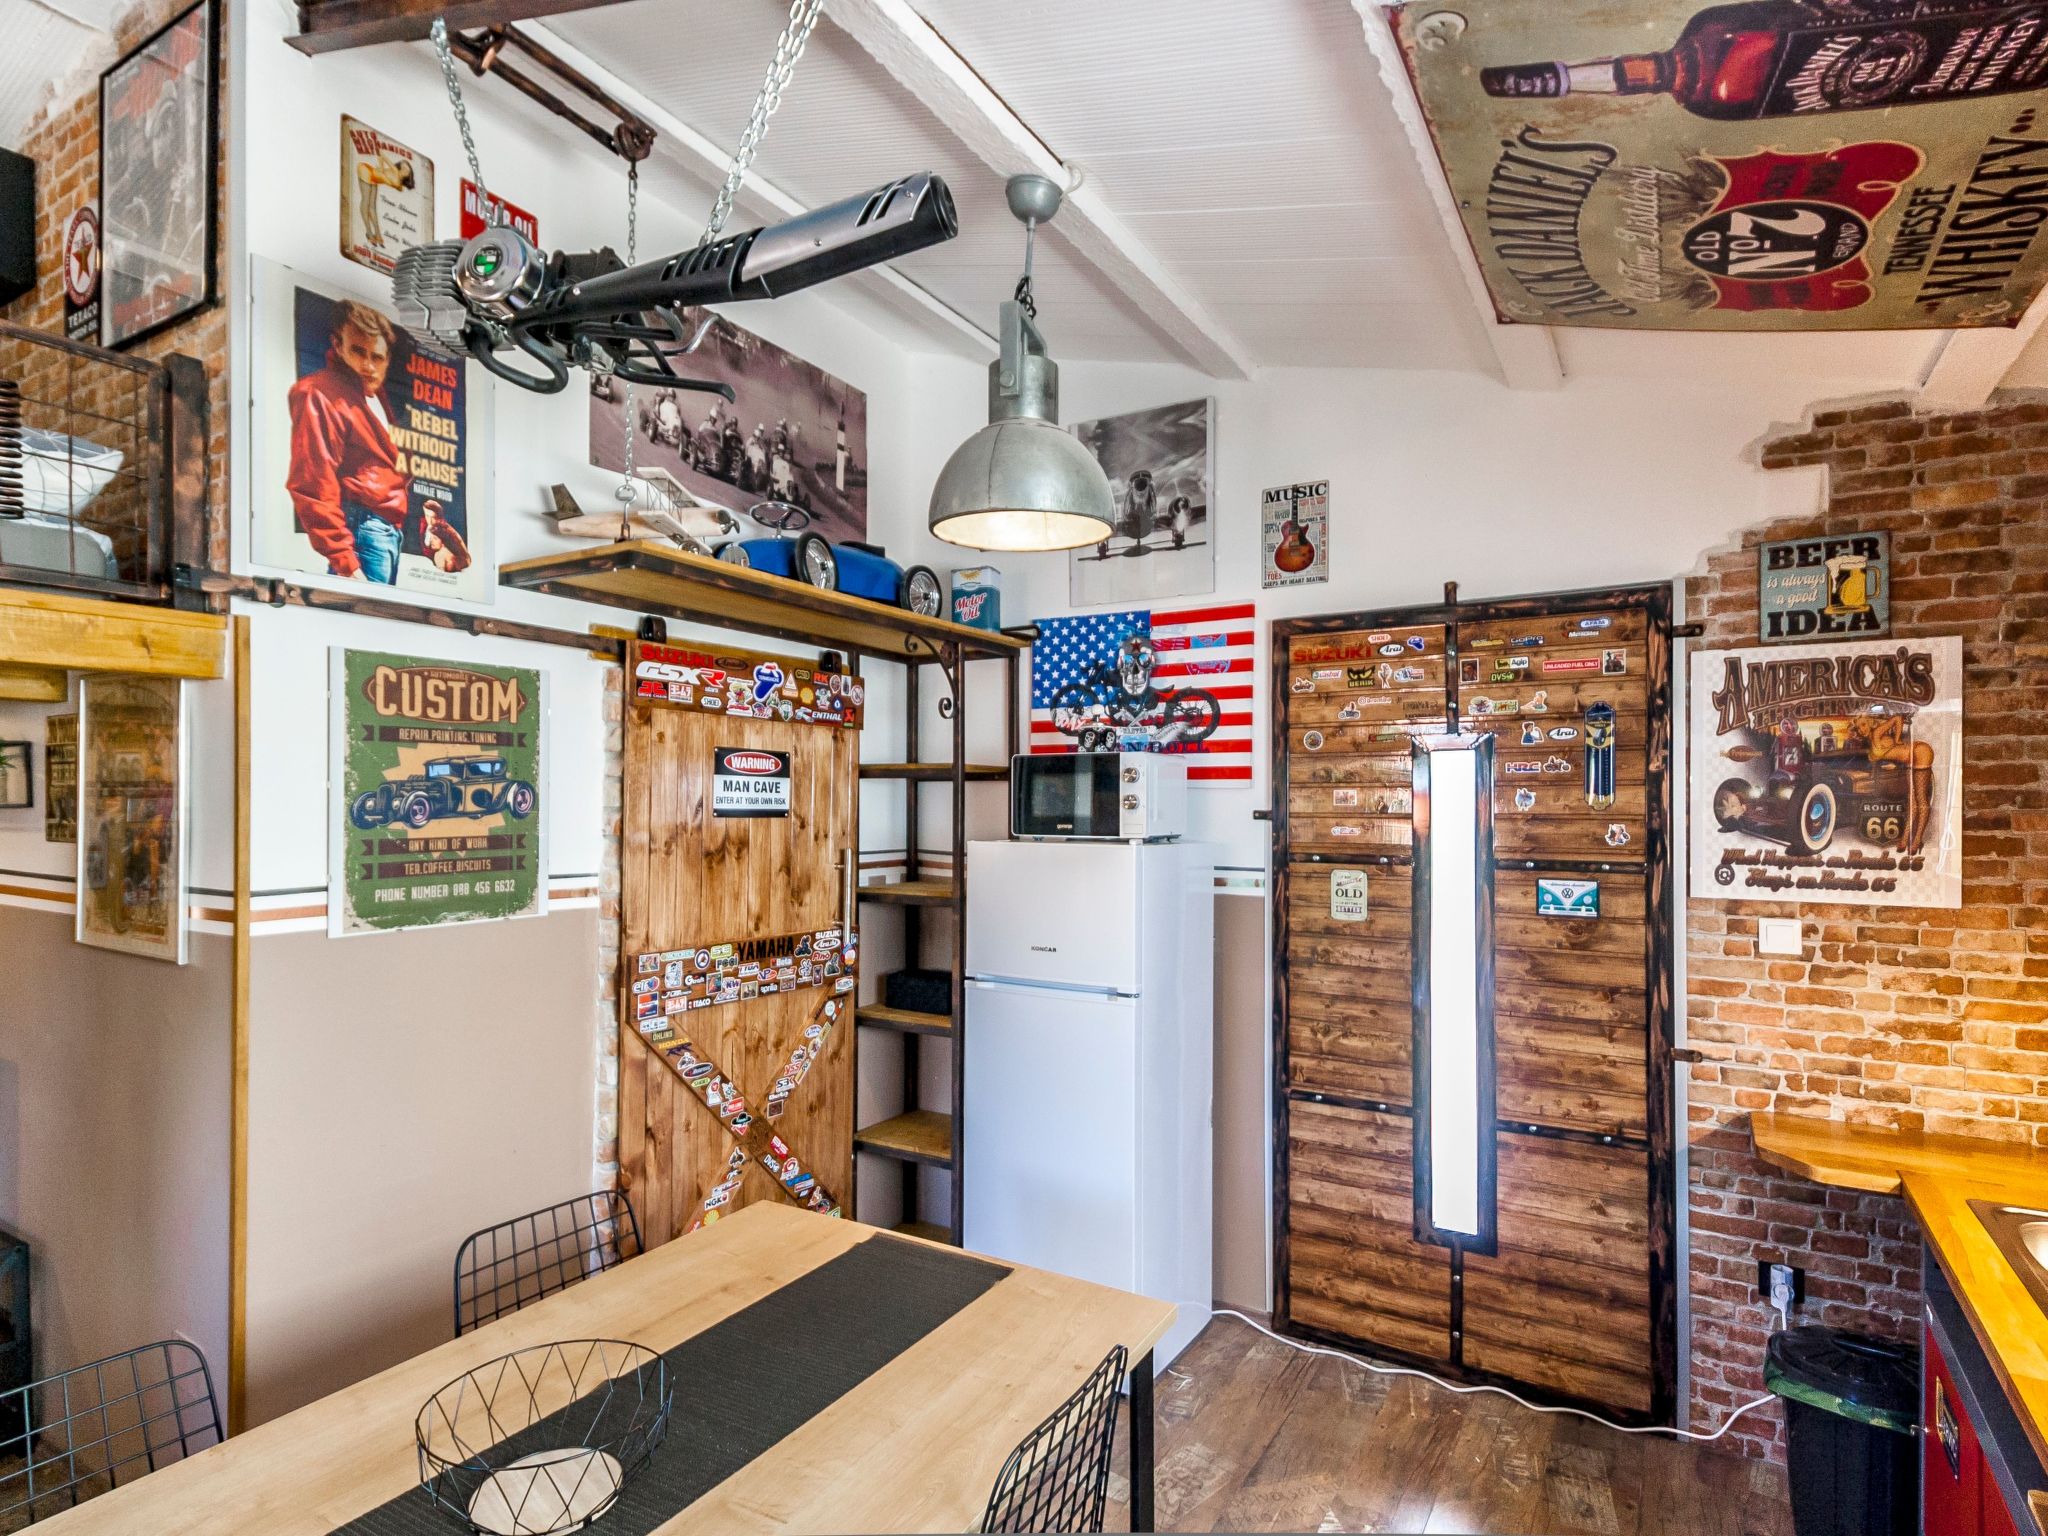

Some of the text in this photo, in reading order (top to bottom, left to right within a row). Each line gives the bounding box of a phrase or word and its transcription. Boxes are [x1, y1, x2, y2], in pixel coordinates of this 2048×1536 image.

[1970, 18, 2041, 90] WHISKEY
[1615, 166, 1680, 244] Distillery
[1487, 124, 1638, 316] JACK DANIEL'S
[1882, 183, 1958, 275] TENNESSEE
[1689, 231, 1722, 262] OLD
[1832, 222, 1862, 258] BRAND
[1617, 245, 1661, 281] Time
[405, 352, 457, 388] JAMES
[413, 379, 454, 410] DEAN
[405, 403, 458, 441] "REBEL
[389, 425, 457, 464] WITHOUT
[396, 452, 463, 487] A CAUSE"
[1264, 483, 1328, 504] MUSIC
[1767, 537, 1881, 570] BEER
[1280, 578, 1288, 586] MY
[1767, 573, 1826, 590] is always
[955, 592, 988, 612] Motor
[1776, 589, 1818, 608] a good
[961, 604, 980, 621] Oil
[1767, 605, 1881, 638] IDEA
[1510, 635, 1544, 643] GoPro
[641, 644, 713, 669] SUZUKI
[1294, 645, 1373, 663] SUZUKI
[1511, 658, 1528, 668] Agip
[814, 672, 828, 684] RK
[1349, 679, 1374, 688] BERIK
[376, 665, 517, 724] CUSTOM
[1712, 646, 1936, 736] AMERICA'S
[731, 756, 775, 770] WARNING
[1506, 762, 1542, 773] HRC
[723, 780, 781, 793] MAN CAVE
[716, 796, 734, 804] ENTER
[1864, 803, 1903, 813] ROUTE
[1866, 817, 1900, 840] 66
[409, 839, 424, 851] ANY
[452, 838, 461, 849] OF
[375, 888, 406, 902] PHONE
[411, 884, 448, 899] NUMBER
[474, 881, 490, 894] 456
[495, 879, 515, 893] 6632
[1335, 888, 1363, 898] OLD
[815, 930, 842, 940] SUZUKI
[738, 936, 795, 961] YAMAHA
[633, 980, 649, 993] elf
[705, 1195, 723, 1209] NGK
